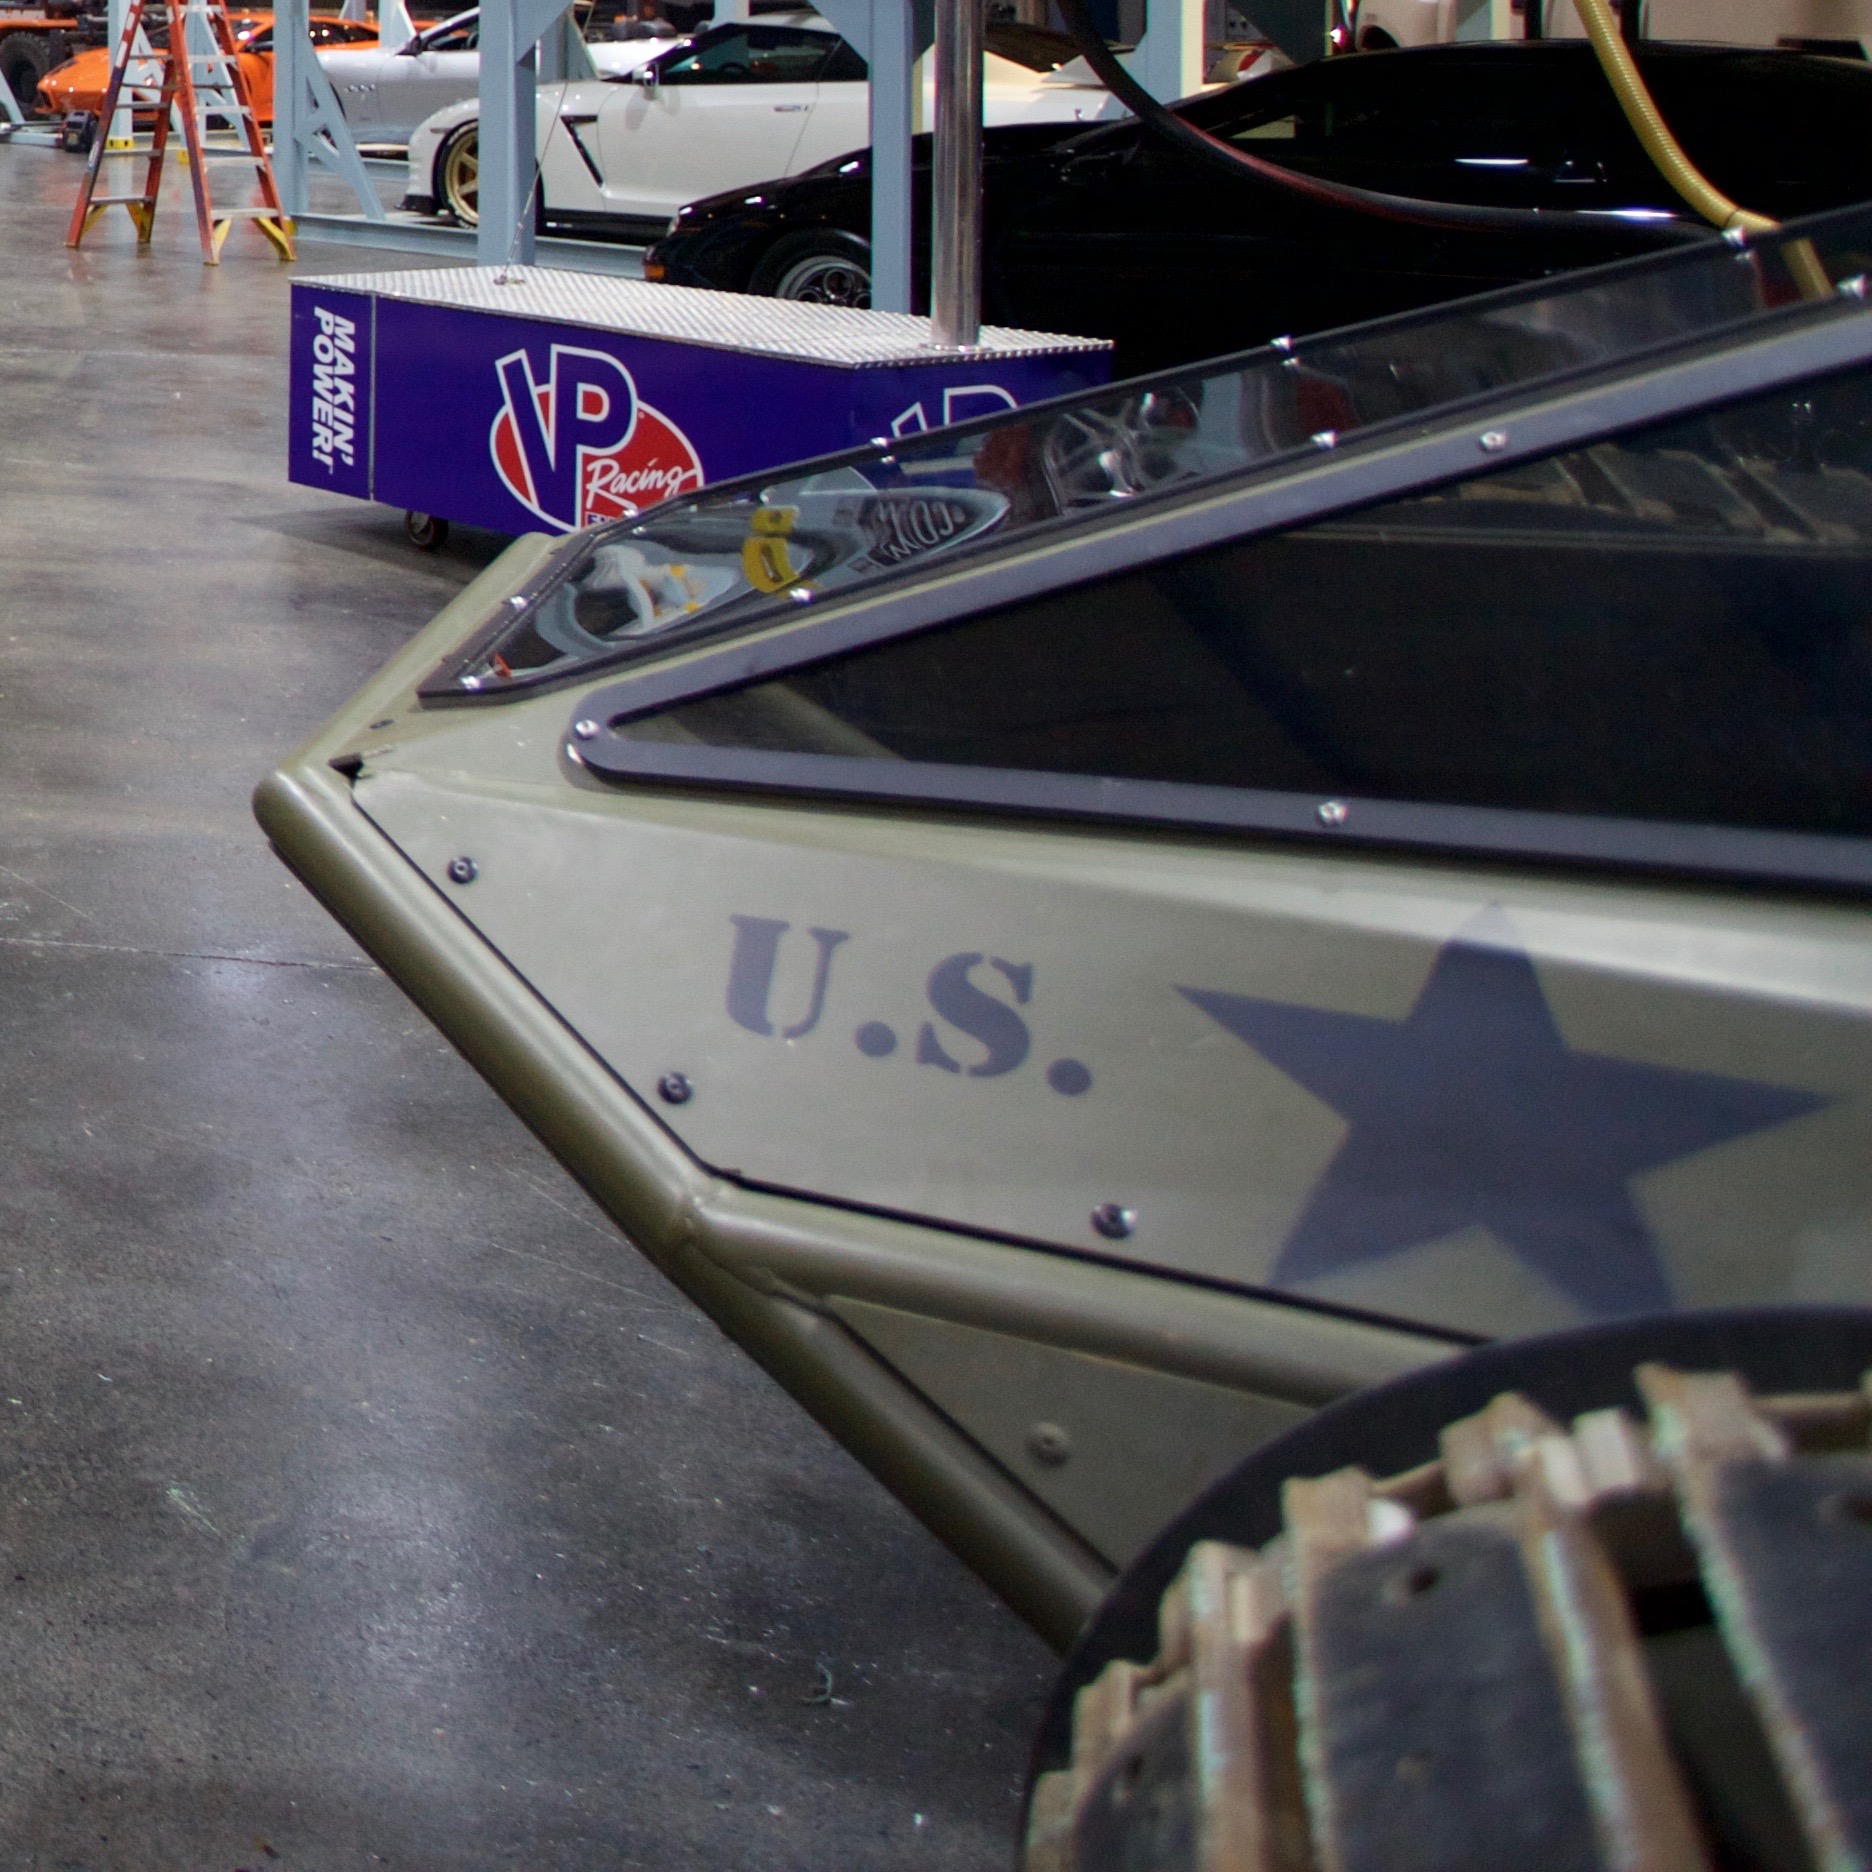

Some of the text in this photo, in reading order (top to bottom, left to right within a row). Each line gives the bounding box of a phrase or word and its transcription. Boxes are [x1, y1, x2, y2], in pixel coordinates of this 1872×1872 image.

[312, 306, 335, 471] POWER!
[333, 314, 356, 467] MAKIN'
[494, 343, 639, 534] VP
[586, 457, 696, 510] Racing
[725, 913, 1093, 1097] U.S.
